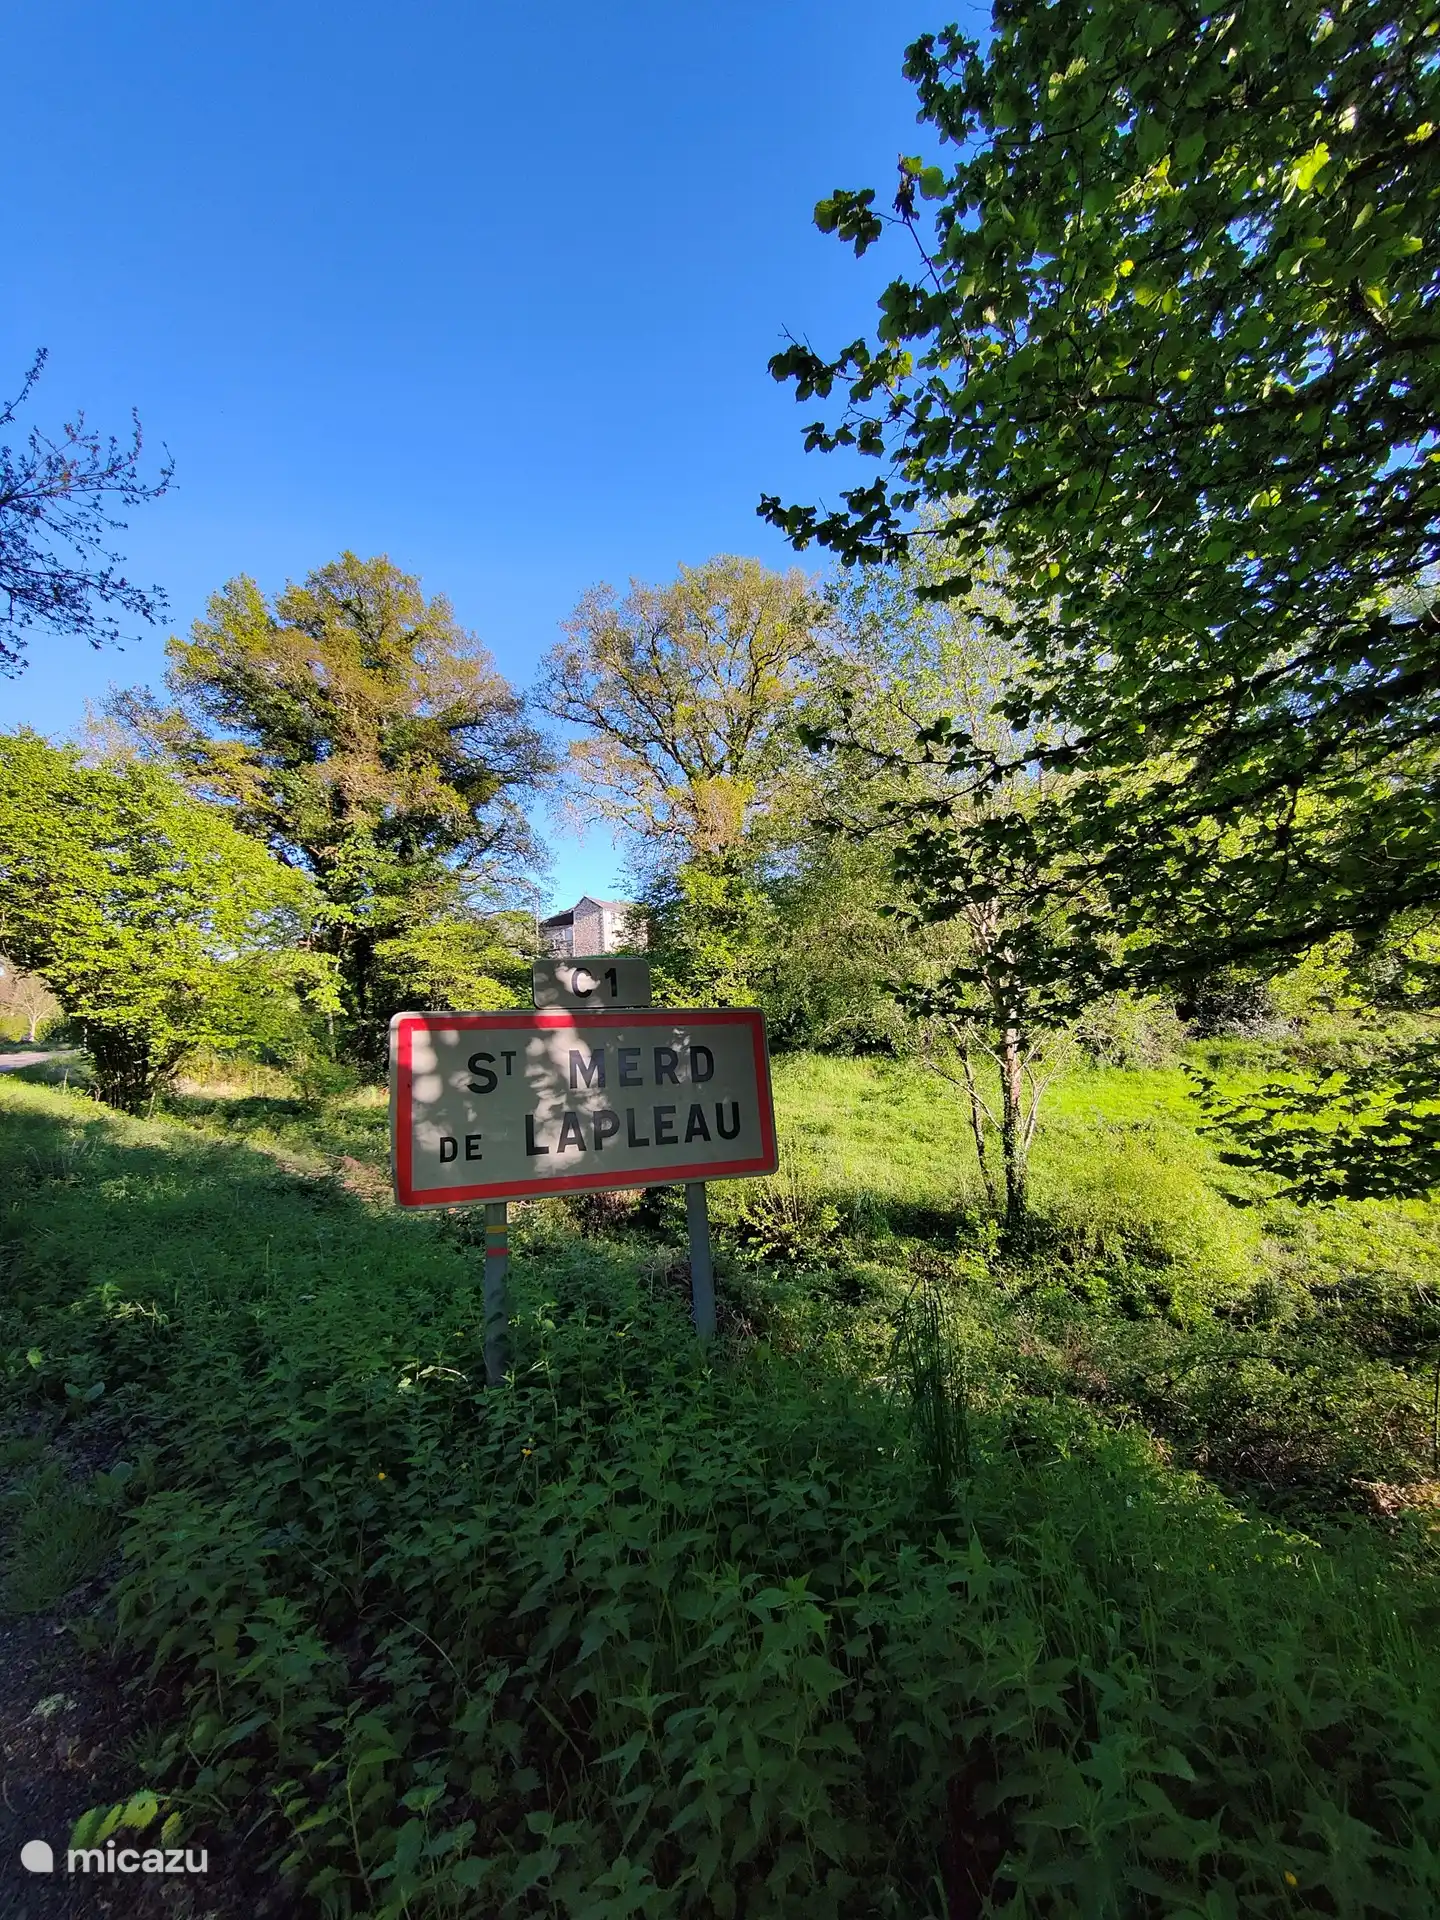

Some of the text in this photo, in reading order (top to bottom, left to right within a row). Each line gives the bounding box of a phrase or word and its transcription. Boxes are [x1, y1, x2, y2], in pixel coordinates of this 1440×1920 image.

[571, 967, 618, 998] C 1
[568, 1045, 715, 1090] MERD
[439, 1101, 741, 1164] DE LAPLEAU
